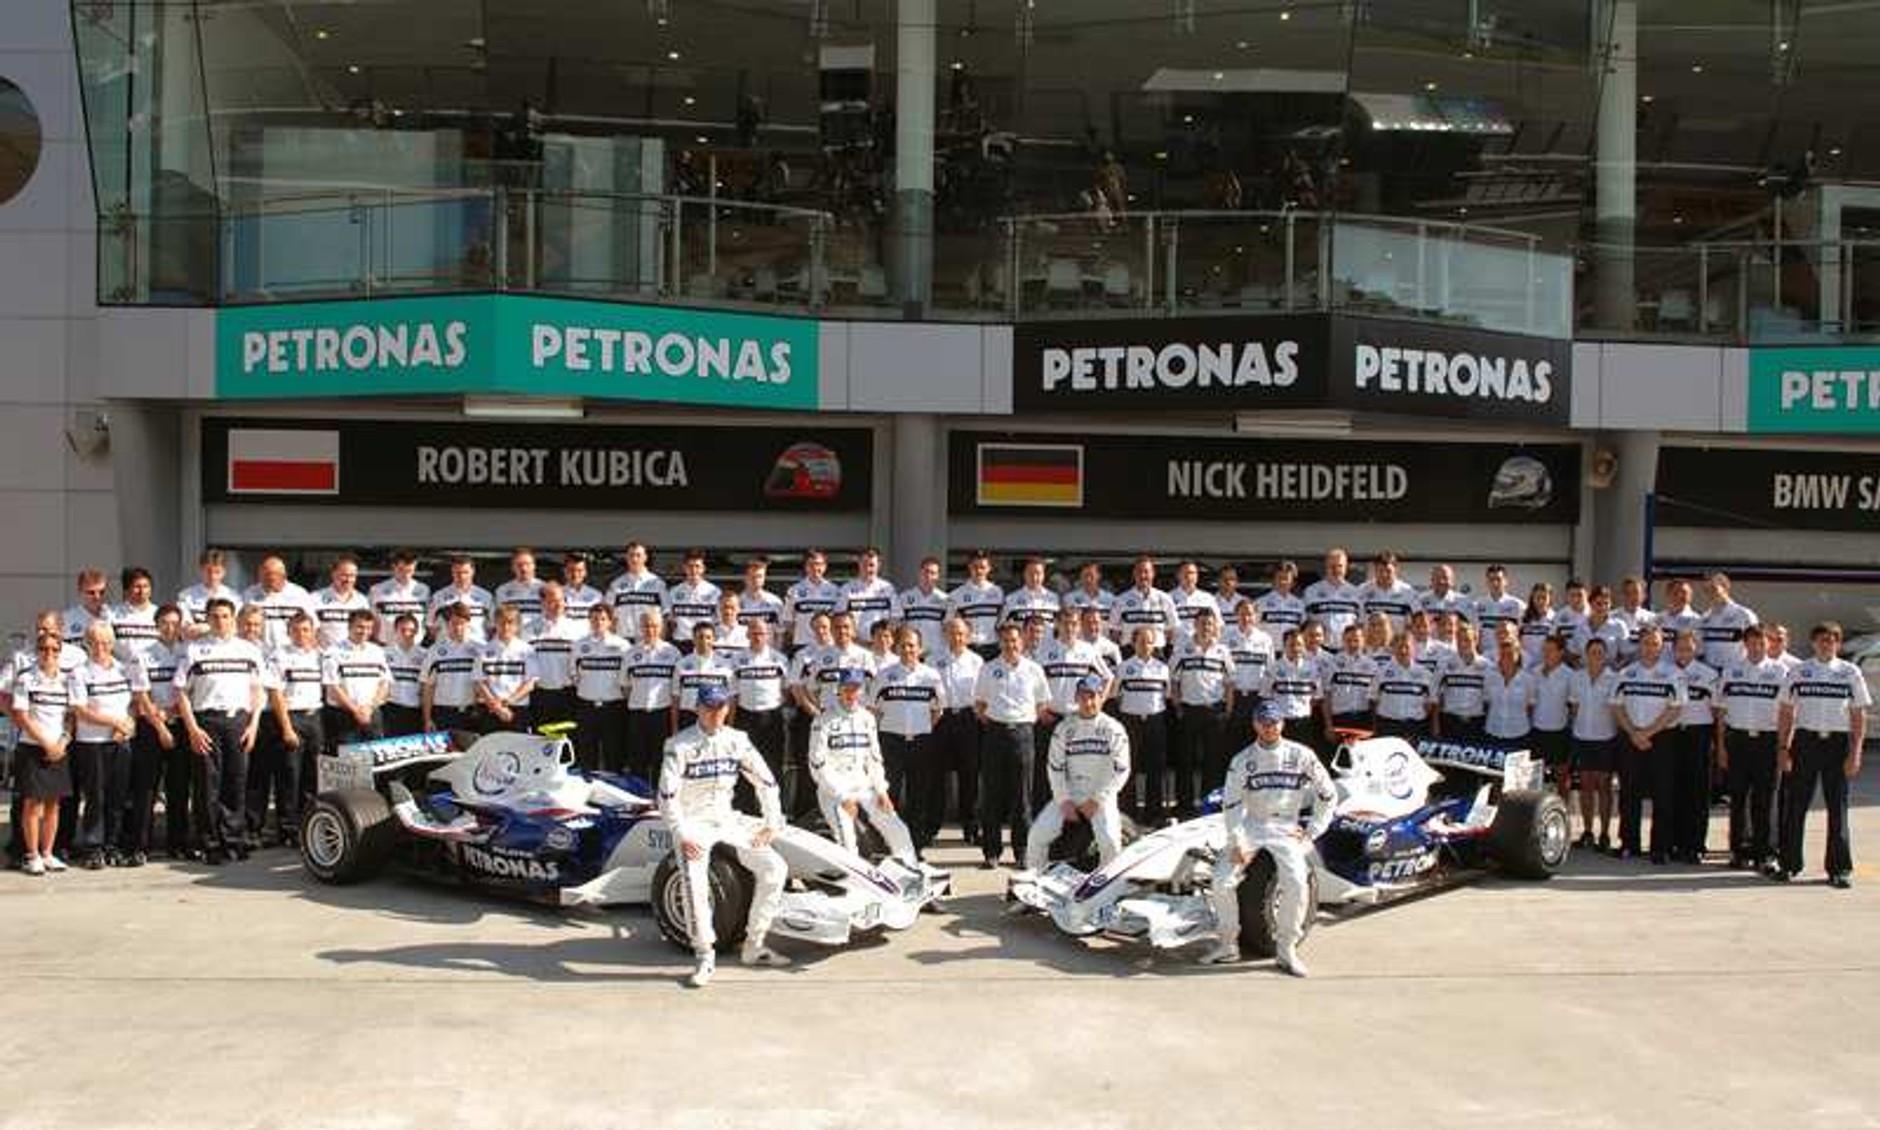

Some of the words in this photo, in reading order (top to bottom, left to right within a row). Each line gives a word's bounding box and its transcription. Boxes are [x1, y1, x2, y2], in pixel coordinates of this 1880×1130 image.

[243, 321, 466, 374] PETRONAS
[531, 323, 792, 384] PETRONAS
[1043, 341, 1299, 390] PETRONAS
[1354, 343, 1552, 404] PETRONAS
[416, 446, 548, 485] ROBERT
[559, 449, 689, 487] KUBICA
[1167, 459, 1249, 498] NICK
[1256, 462, 1409, 501] HEIDFELD
[1773, 473, 1851, 509] BMW
[1418, 740, 1505, 769] PETRONA
